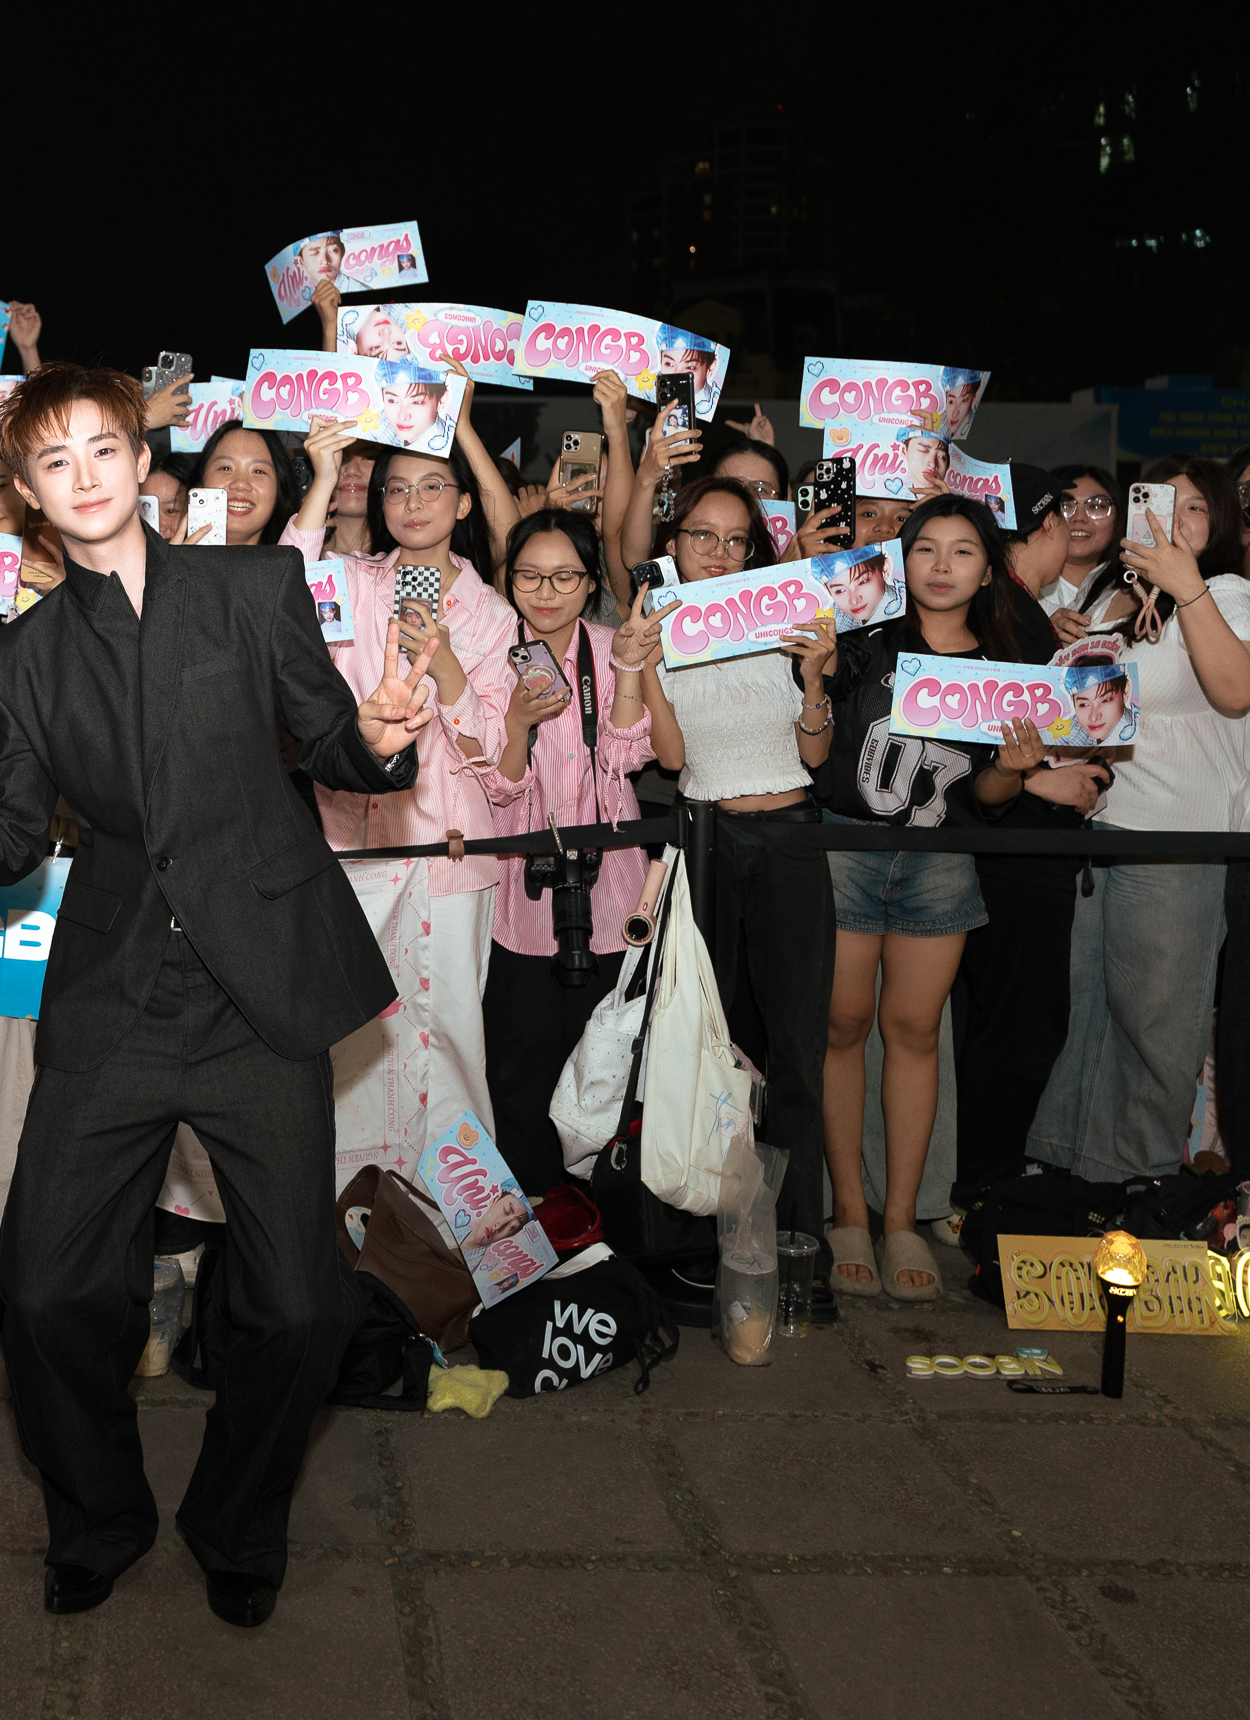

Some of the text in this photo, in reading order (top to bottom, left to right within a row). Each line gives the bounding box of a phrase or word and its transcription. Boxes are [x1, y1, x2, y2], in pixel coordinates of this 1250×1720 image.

[344, 233, 411, 270] congs
[444, 313, 476, 324] UNICONGS
[524, 321, 650, 377] CONGB
[252, 369, 370, 420] CONGB
[808, 378, 938, 420] CONGB
[878, 416, 914, 426] UNICONGS
[947, 470, 1001, 502] congs
[671, 579, 820, 655] CONGB
[754, 626, 794, 639] UNICONGS
[581, 675, 593, 715] Canon
[902, 678, 1061, 730] CONGB
[365, 870, 387, 881] CONG
[386, 1043, 394, 1074] NGUYEN
[387, 1076, 395, 1106] THANH
[348, 1151, 379, 1163] NGUYEN
[1011, 1254, 1239, 1333] SOBIN
[553, 1300, 617, 1345] we
[541, 1320, 613, 1378] love
